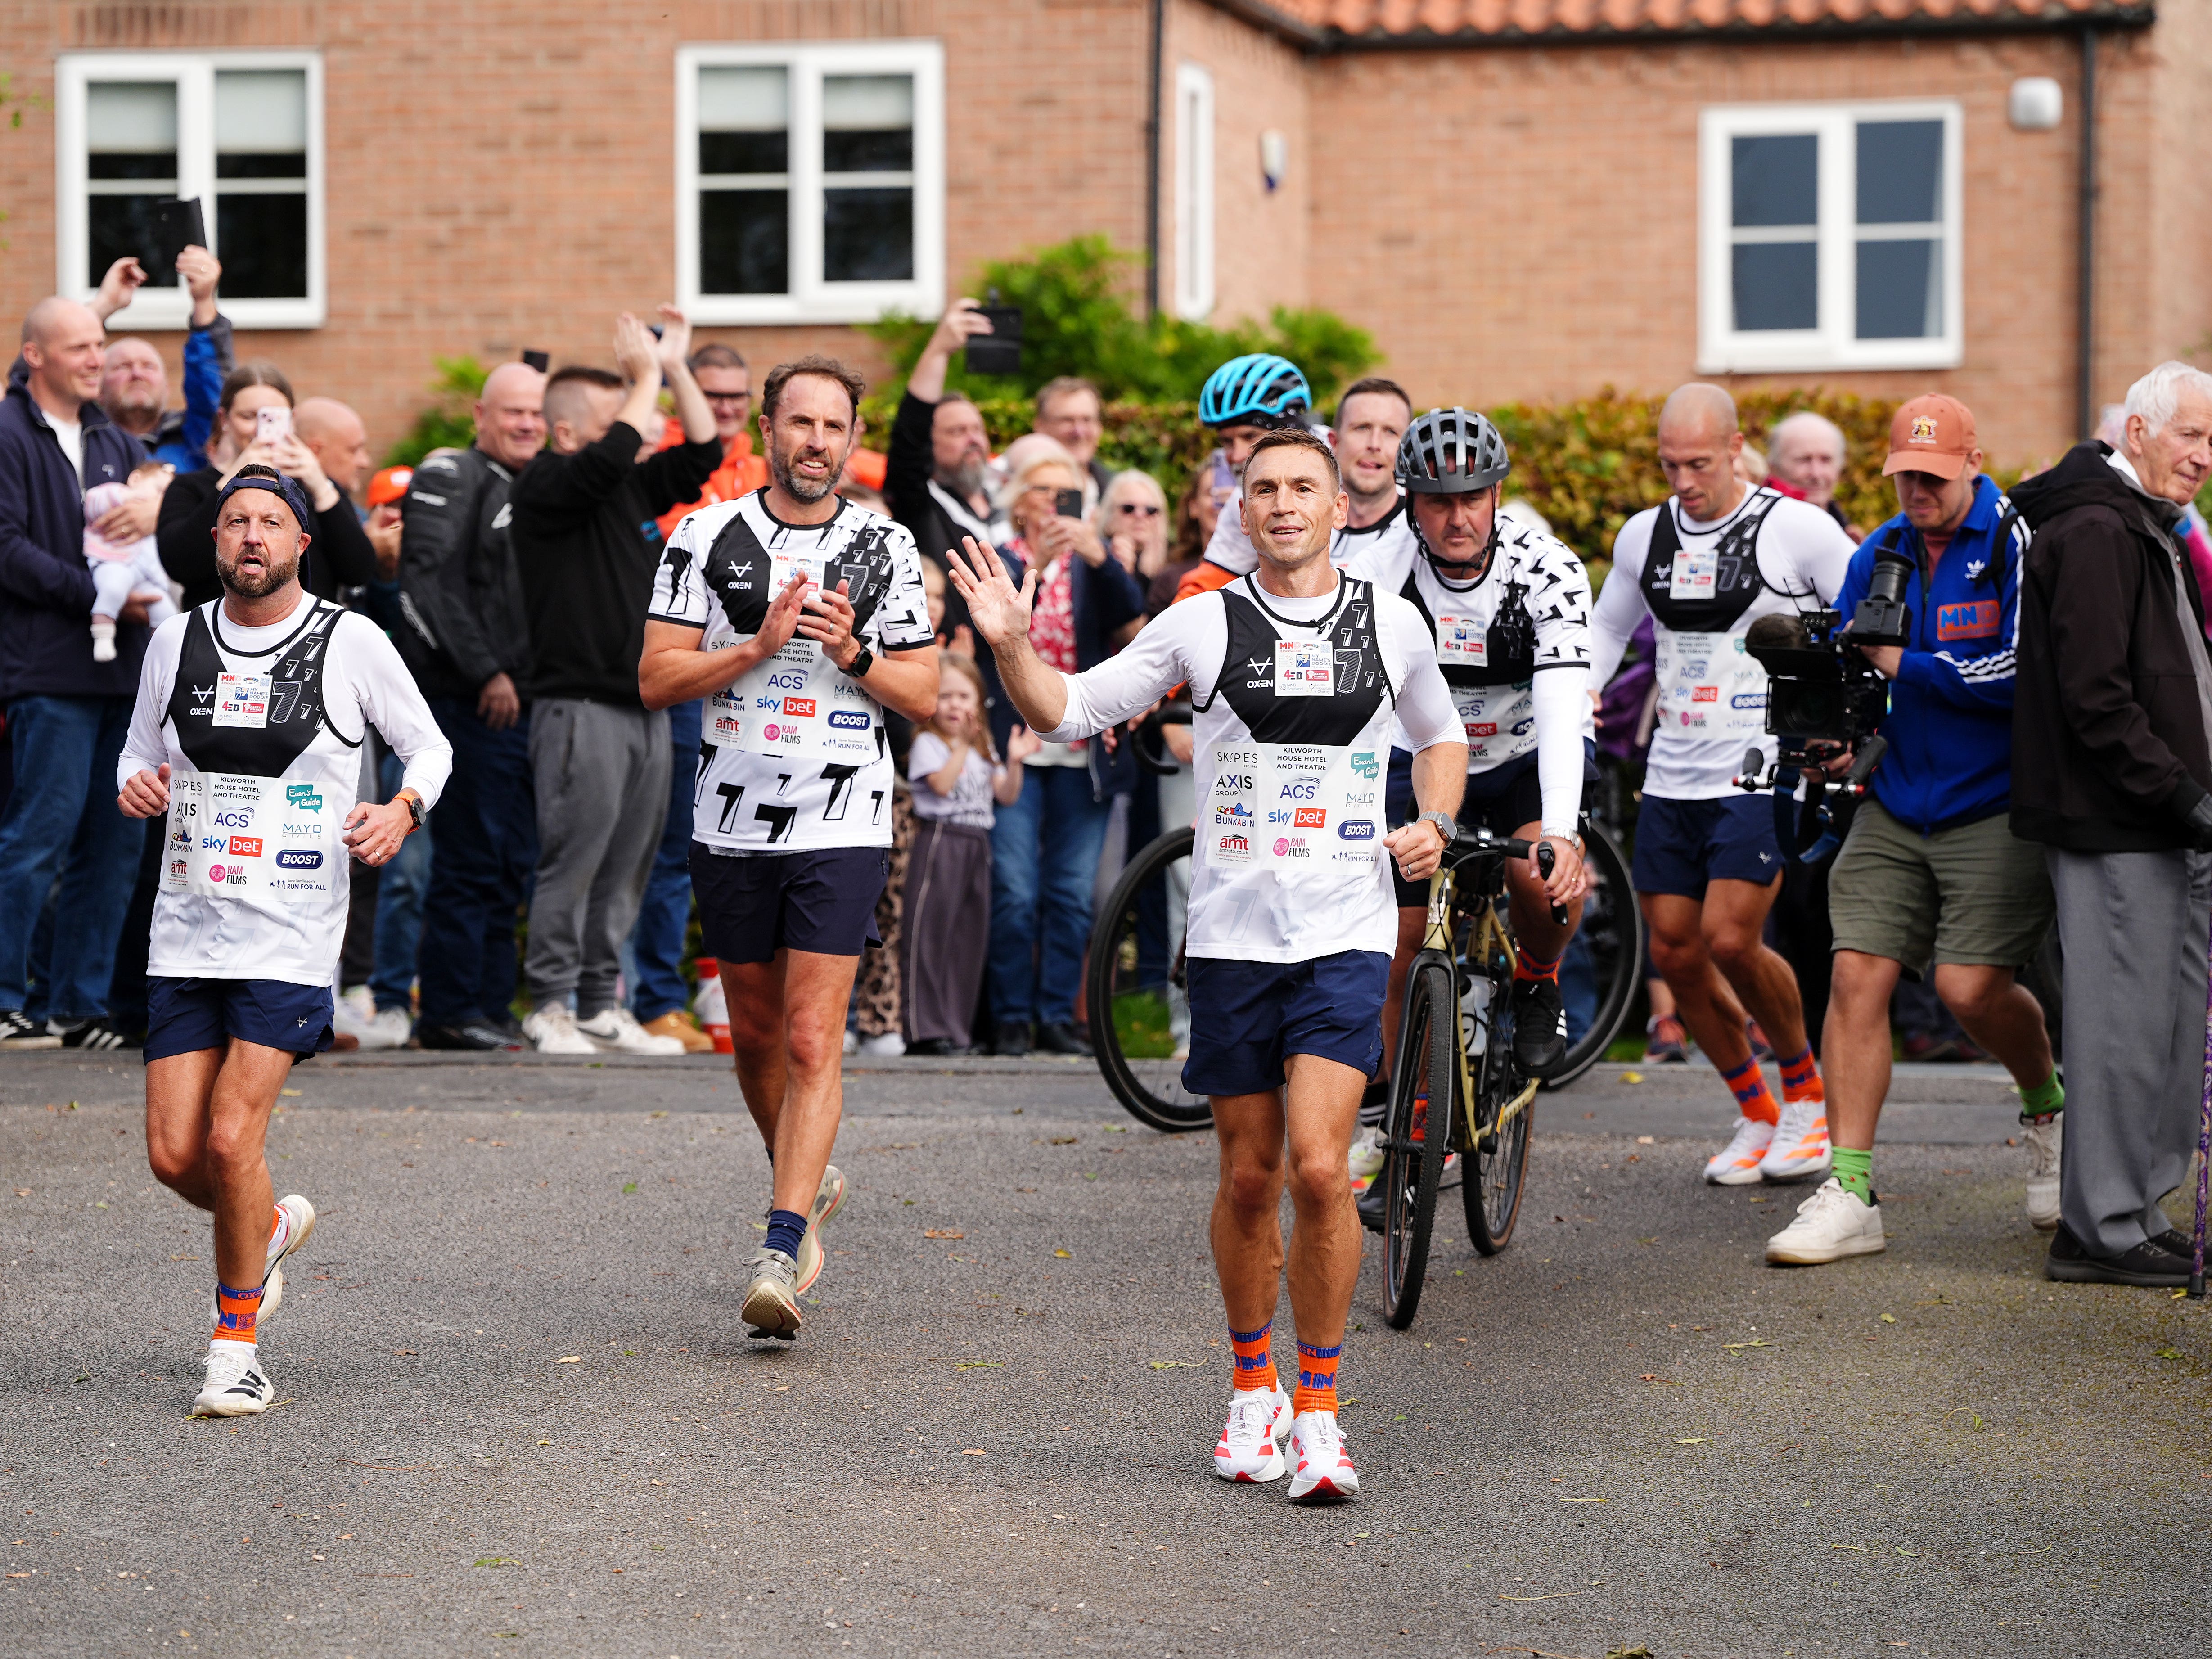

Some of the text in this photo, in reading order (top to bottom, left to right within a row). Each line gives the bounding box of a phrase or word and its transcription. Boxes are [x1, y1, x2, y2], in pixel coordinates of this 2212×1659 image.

[1718, 556, 1742, 591] 7
[728, 582, 752, 590] OXEN
[841, 564, 869, 604] 7
[1941, 604, 1997, 627] MND
[1334, 649, 1362, 694] 7
[1680, 667, 1705, 679] ACS
[767, 674, 803, 690] ACS
[1247, 679, 1273, 689] OXEN
[270, 681, 302, 723] 7
[712, 697, 744, 711] BUNKABIN
[757, 695, 813, 713] sky bet
[1735, 697, 1766, 707] BOOS
[1459, 705, 1480, 716] CS
[716, 718, 739, 732] amt
[833, 714, 867, 726] BOOST
[782, 725, 797, 735] RAM
[1468, 724, 1495, 735] bet
[781, 734, 800, 744] FILMS
[1365, 767, 1378, 775] Guide
[1216, 775, 1252, 789] AXIS
[1279, 785, 1315, 799] ACS
[1347, 793, 1374, 802] MAYO
[214, 812, 249, 828] ACS
[1216, 814, 1254, 828] BUNKABIN
[1268, 809, 1323, 826] sky bet
[283, 823, 321, 833] MAYO
[1345, 825, 1371, 835] BOOST
[170, 841, 193, 852] BUNKABIN
[203, 835, 259, 853] sky bet
[1220, 837, 1249, 850] amt
[1291, 838, 1306, 847] RAM
[1288, 848, 1310, 857] FILMS
[282, 854, 319, 865] BOOST
[171, 862, 187, 875] amt
[227, 865, 243, 875] RAM
[227, 875, 247, 885] FILMS
